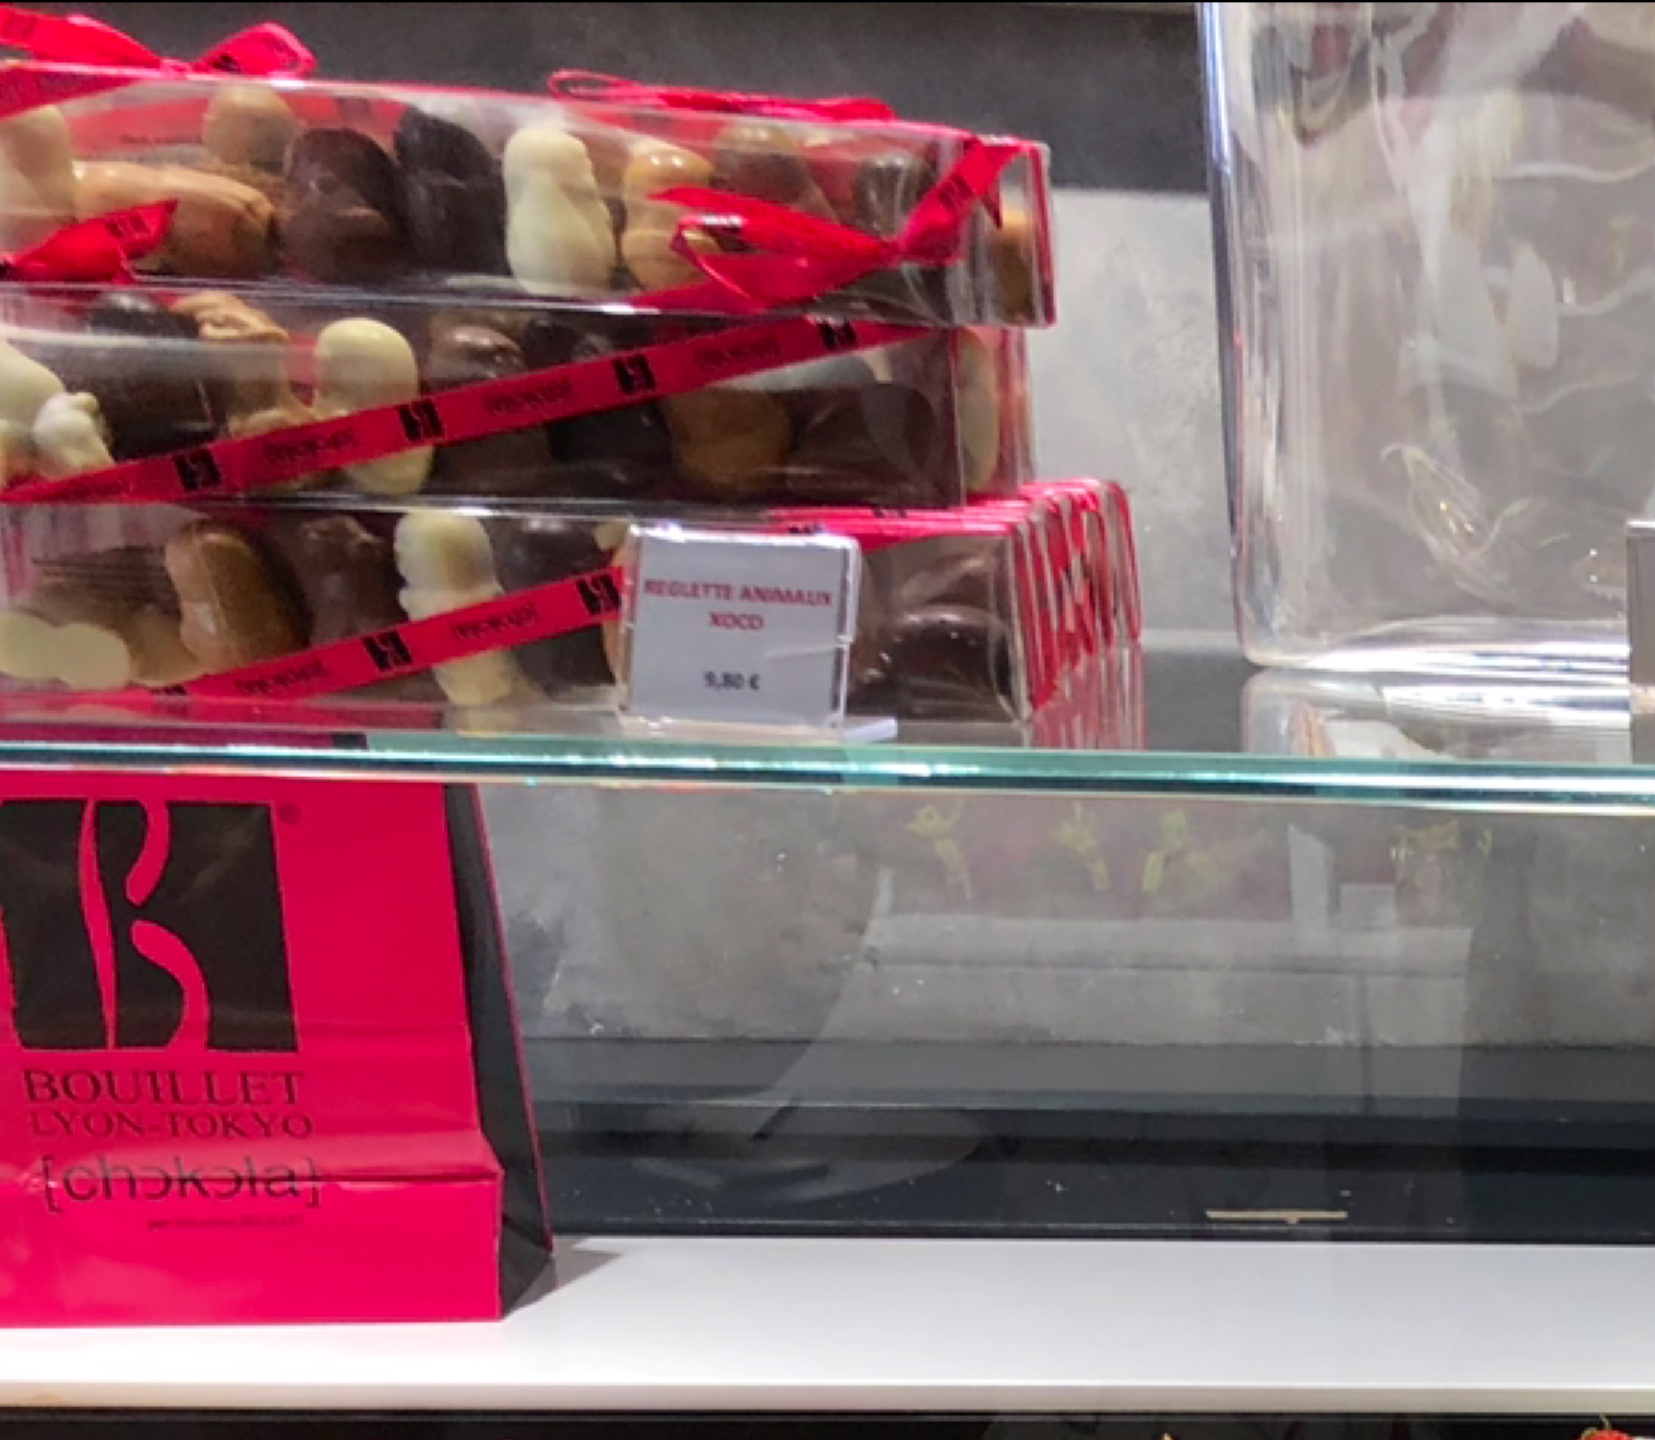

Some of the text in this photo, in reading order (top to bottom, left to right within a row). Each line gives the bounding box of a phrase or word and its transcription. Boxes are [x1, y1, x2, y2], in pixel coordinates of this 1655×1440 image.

[644, 578, 833, 606] REGLETTE ANIMAUX
[709, 610, 765, 631] XOCO
[704, 671, 760, 691] 9,80 €
[23, 1068, 304, 1105] BOUILLET
[31, 1112, 313, 1140] LYON-TOKYO
